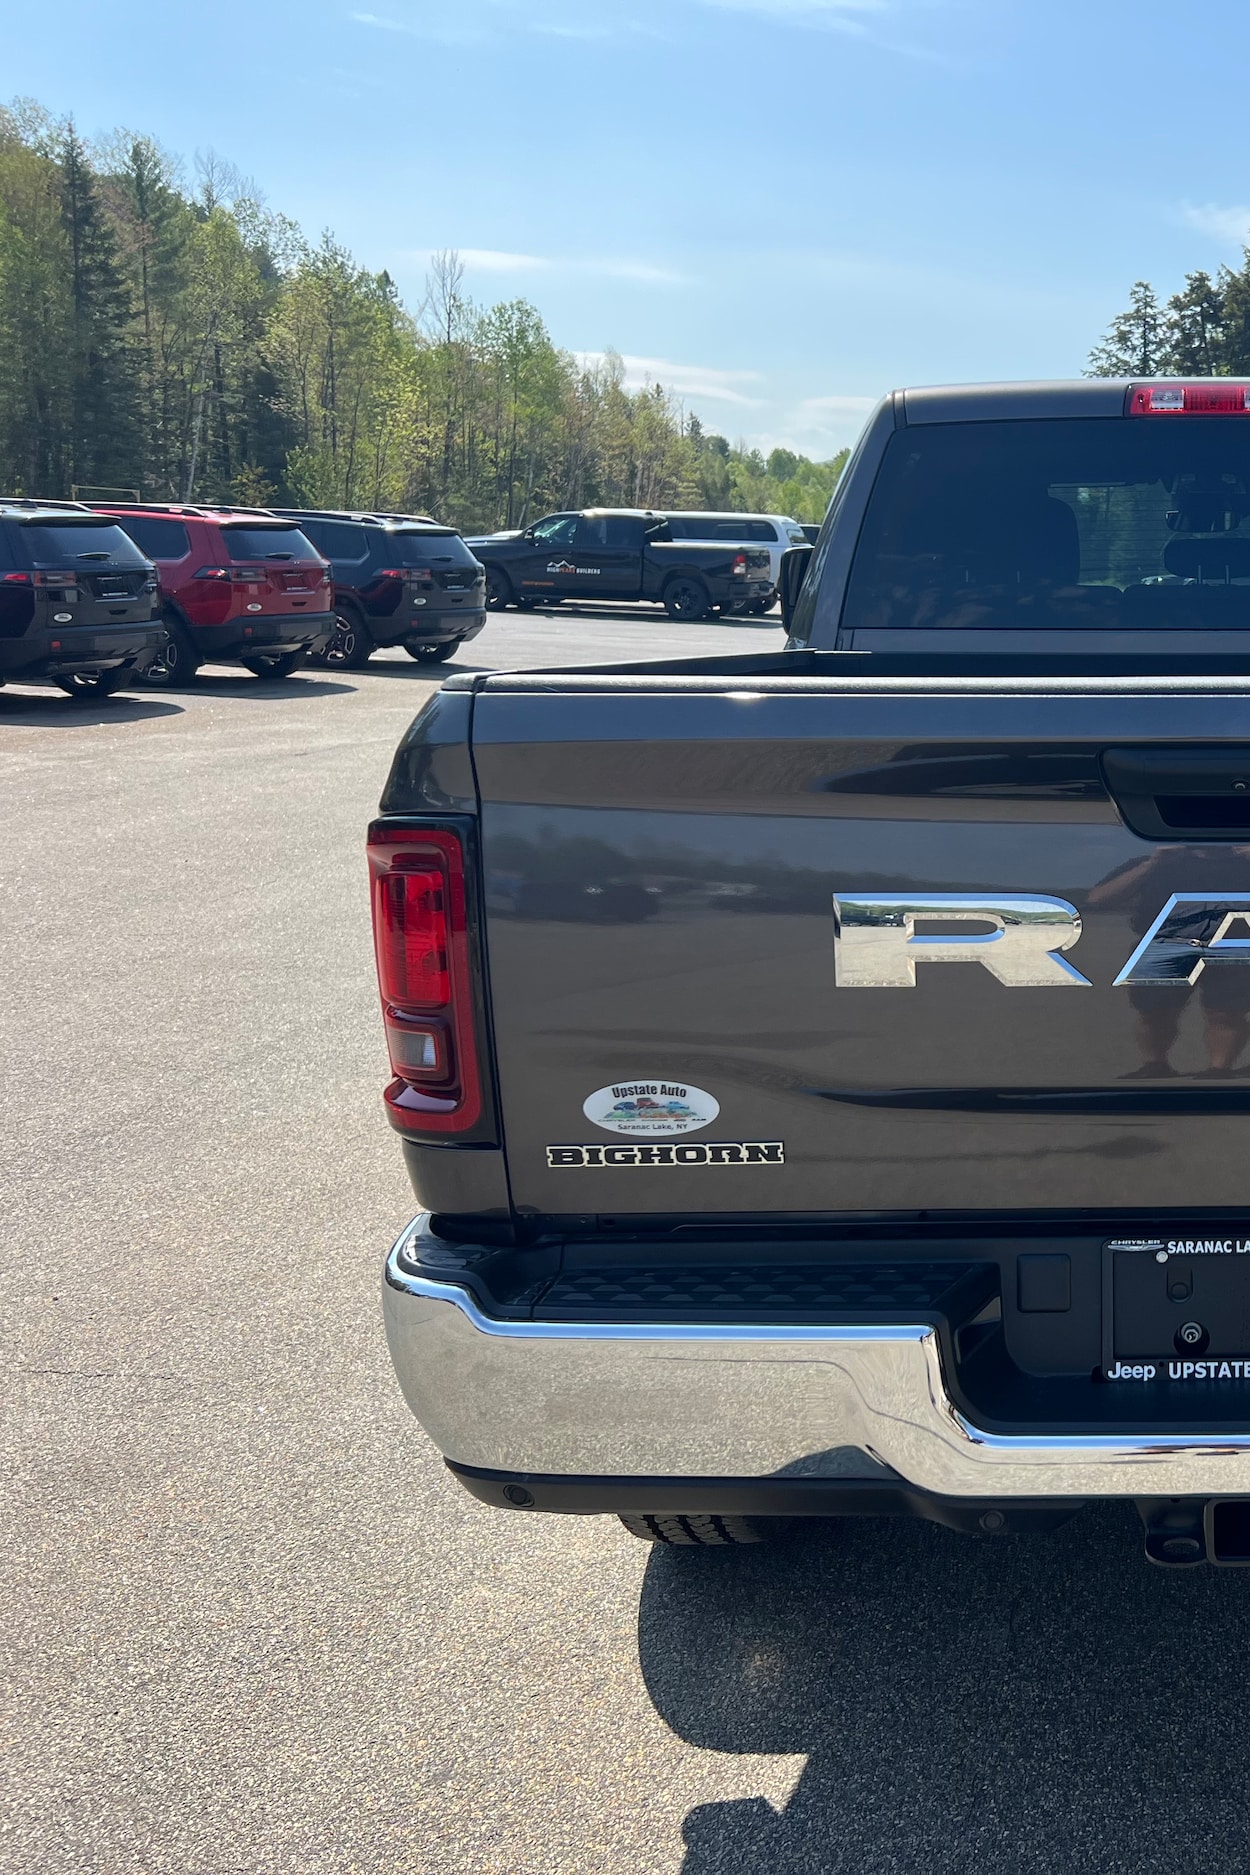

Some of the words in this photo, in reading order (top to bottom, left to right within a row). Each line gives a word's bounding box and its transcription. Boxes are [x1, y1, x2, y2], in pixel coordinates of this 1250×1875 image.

[612, 1084, 657, 1098] Upstate
[660, 1084, 687, 1098] Auto
[546, 1142, 785, 1167] BIGHORN
[1167, 1240, 1233, 1254] SARANAC
[1107, 1361, 1156, 1381] Jeep
